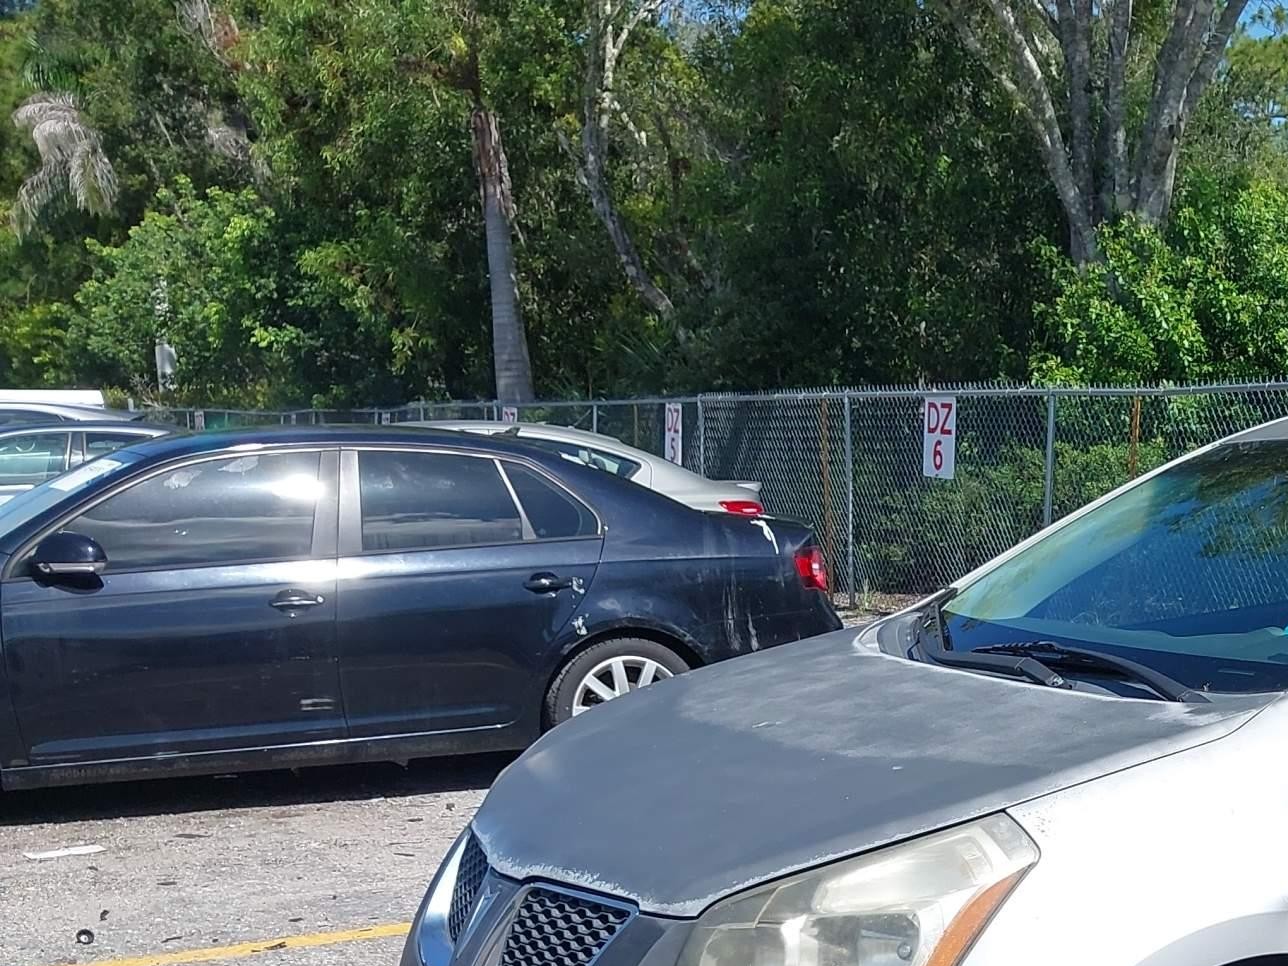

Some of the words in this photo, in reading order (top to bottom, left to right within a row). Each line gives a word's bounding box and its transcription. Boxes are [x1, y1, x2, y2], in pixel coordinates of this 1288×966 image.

[667, 407, 680, 434] DZ
[927, 402, 953, 436] DZ
[670, 437, 676, 463] 5
[933, 439, 943, 471] 6
